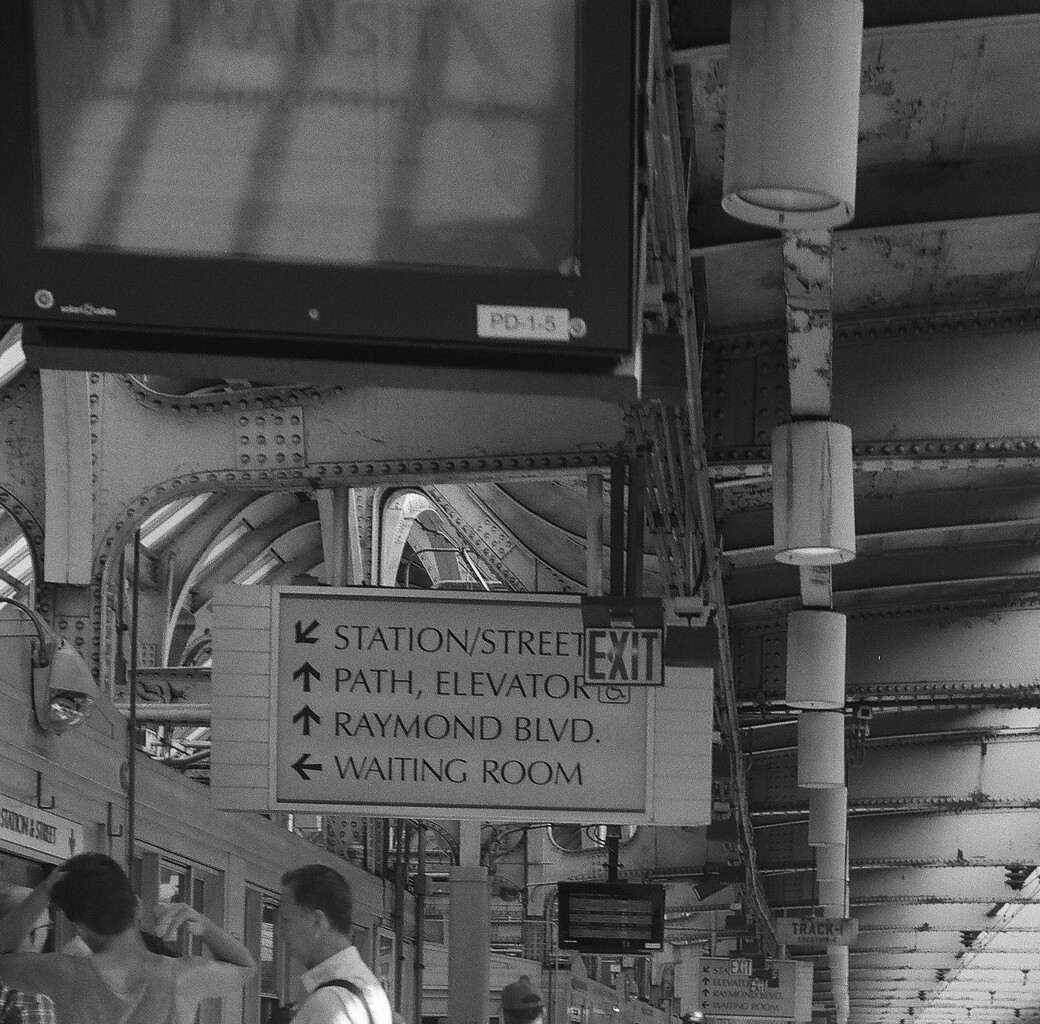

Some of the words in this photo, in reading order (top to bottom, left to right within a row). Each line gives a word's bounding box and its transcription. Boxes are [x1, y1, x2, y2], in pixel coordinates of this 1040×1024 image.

[490, 312, 556, 332] PD-1-5
[334, 624, 584, 658] STATION/STREET
[589, 631, 659, 680] EXIT
[334, 668, 423, 700] PATH,
[436, 671, 591, 700] ELEVATOR
[334, 711, 502, 741] RAYMOND
[515, 717, 601, 744] BLVD.
[334, 755, 467, 784] WAITING
[482, 759, 584, 786] ROOM
[1, 807, 28, 836] STATION
[36, 820, 57, 846] STREET
[713, 978, 751, 987] ELEVATO
[732, 960, 751, 974] EXIT
